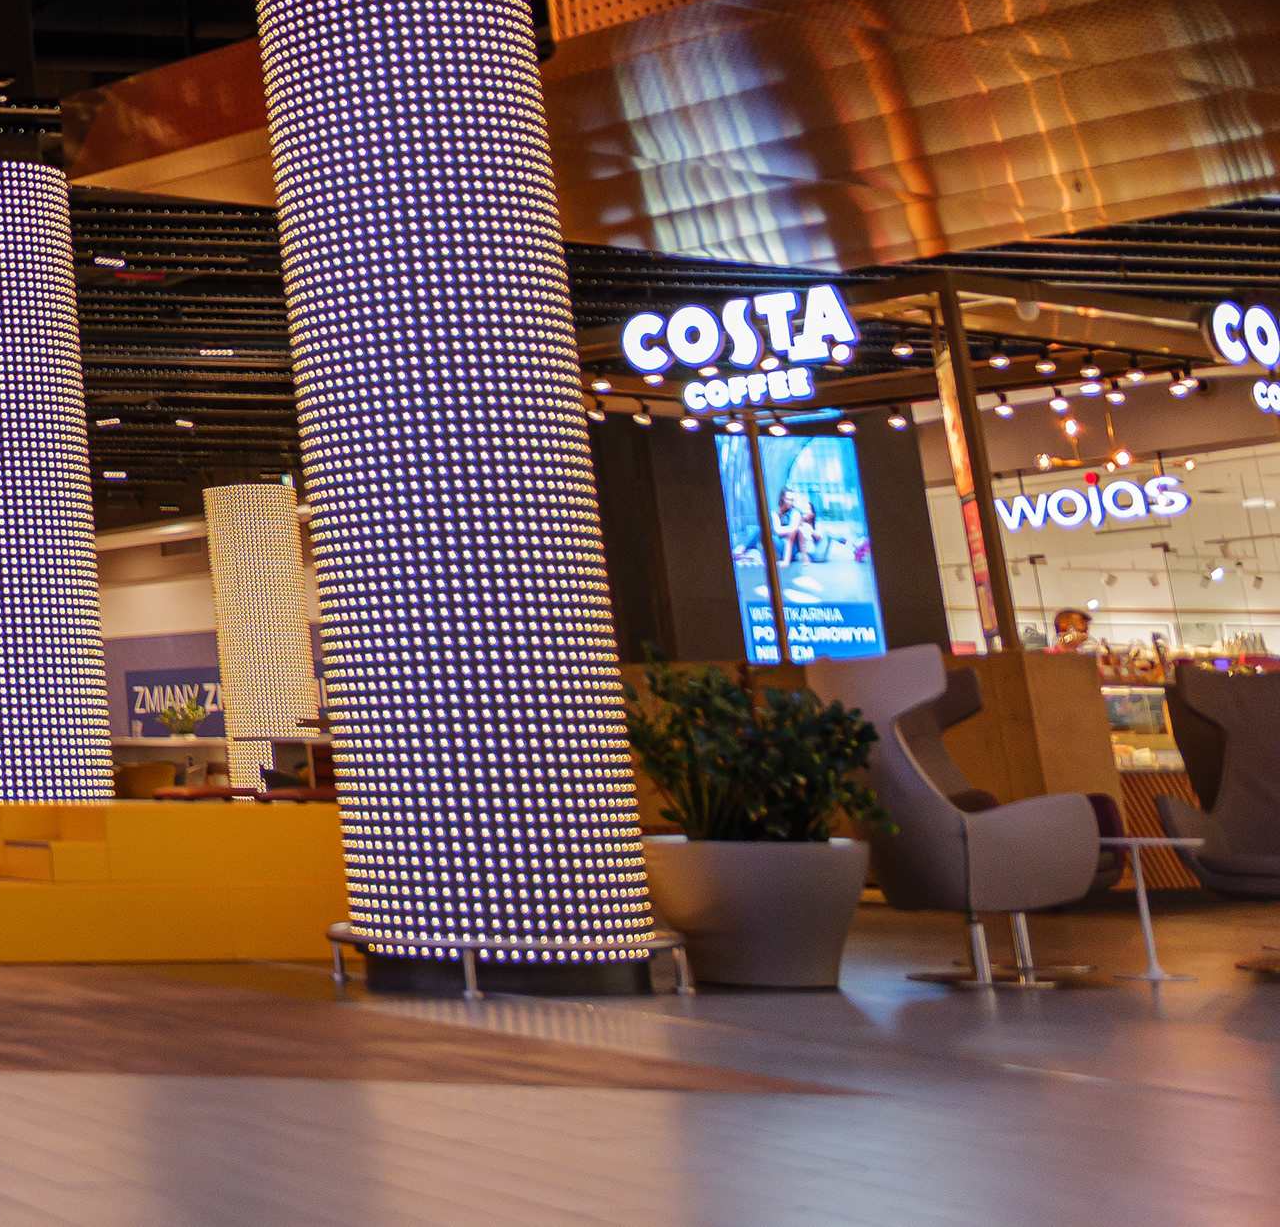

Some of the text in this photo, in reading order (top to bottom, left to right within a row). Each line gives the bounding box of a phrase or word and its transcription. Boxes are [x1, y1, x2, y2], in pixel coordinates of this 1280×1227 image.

[622, 284, 860, 371] COSTA
[683, 367, 814, 412] COFFEE
[994, 471, 1191, 530] wojas
[749, 606, 844, 623] WRTKARNIA
